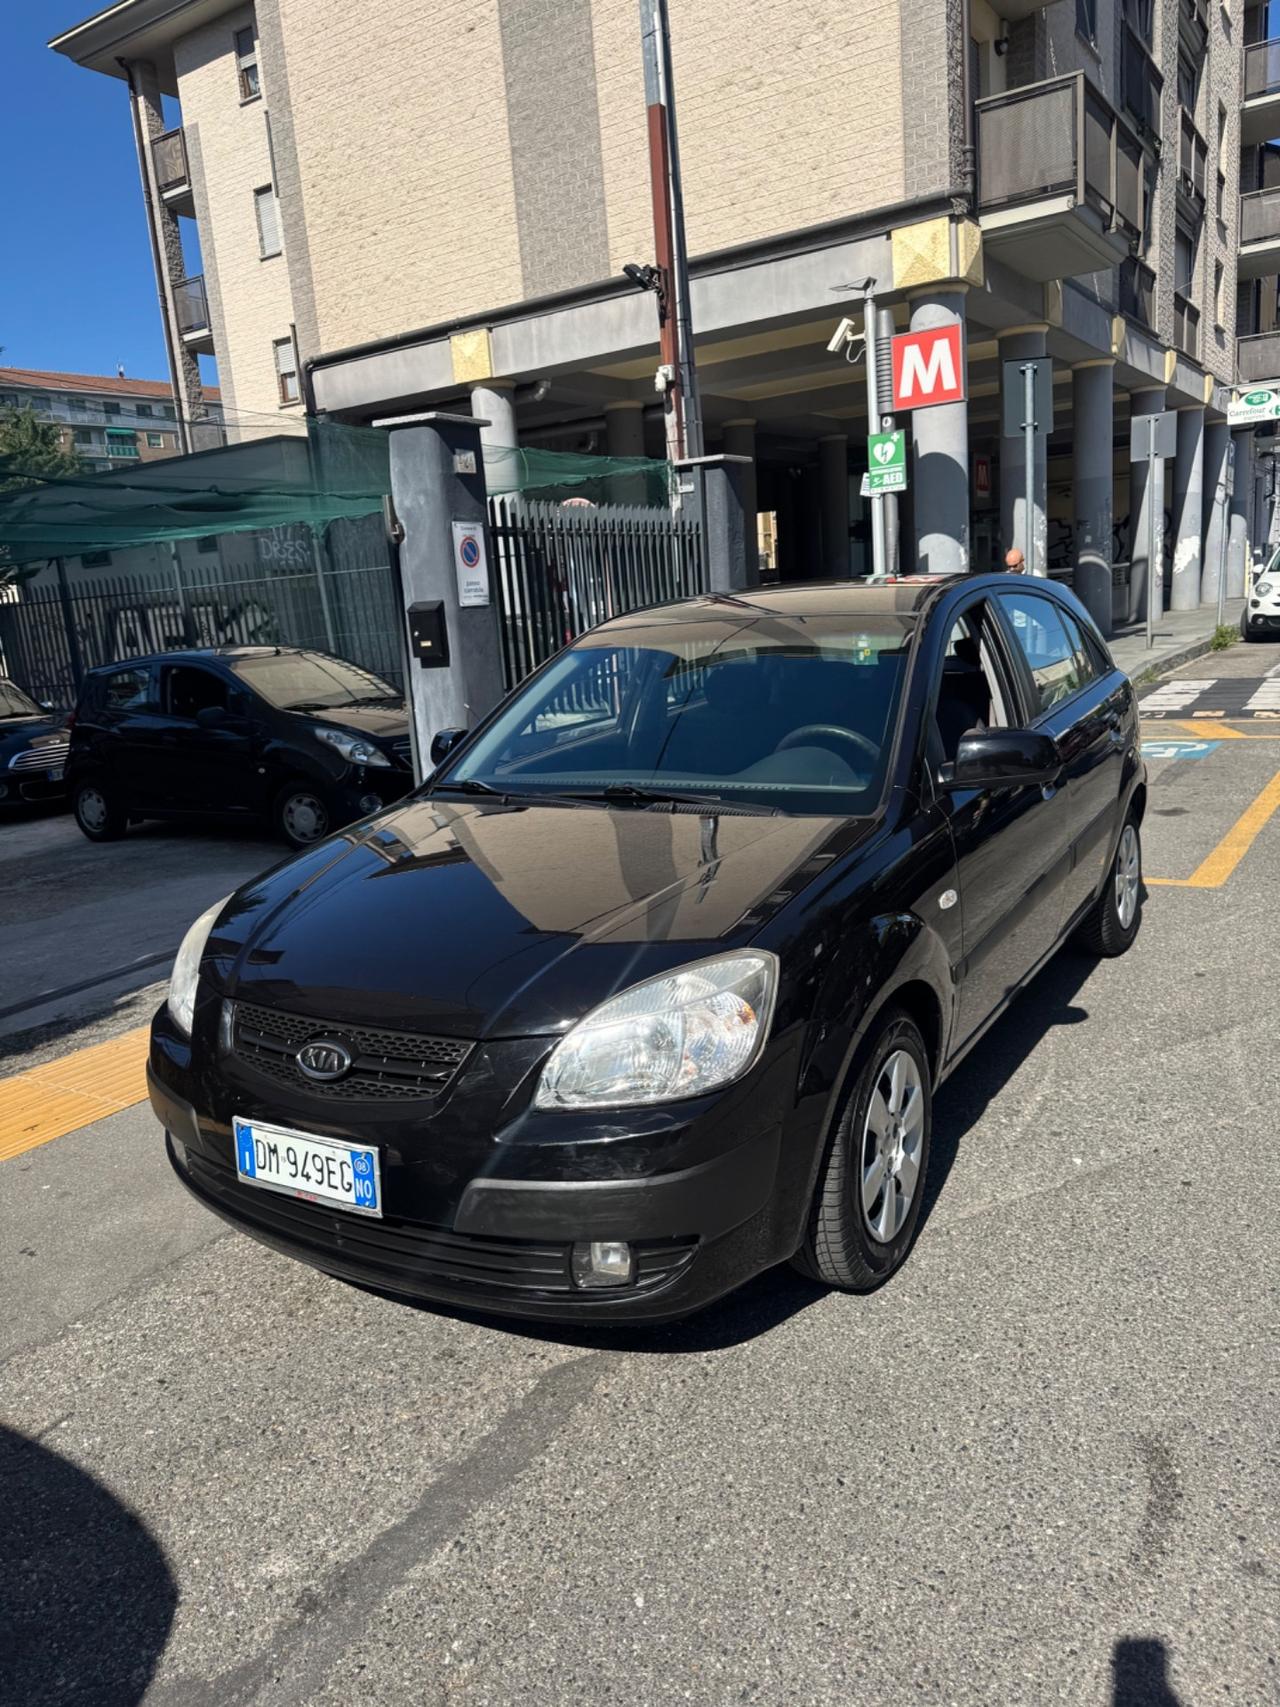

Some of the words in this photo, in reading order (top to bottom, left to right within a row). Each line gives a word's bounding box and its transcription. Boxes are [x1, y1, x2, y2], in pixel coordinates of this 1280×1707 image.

[899, 338, 957, 399] M
[882, 471, 904, 486] AED
[306, 1048, 338, 1072] KIA
[354, 1177, 373, 1200] NO
